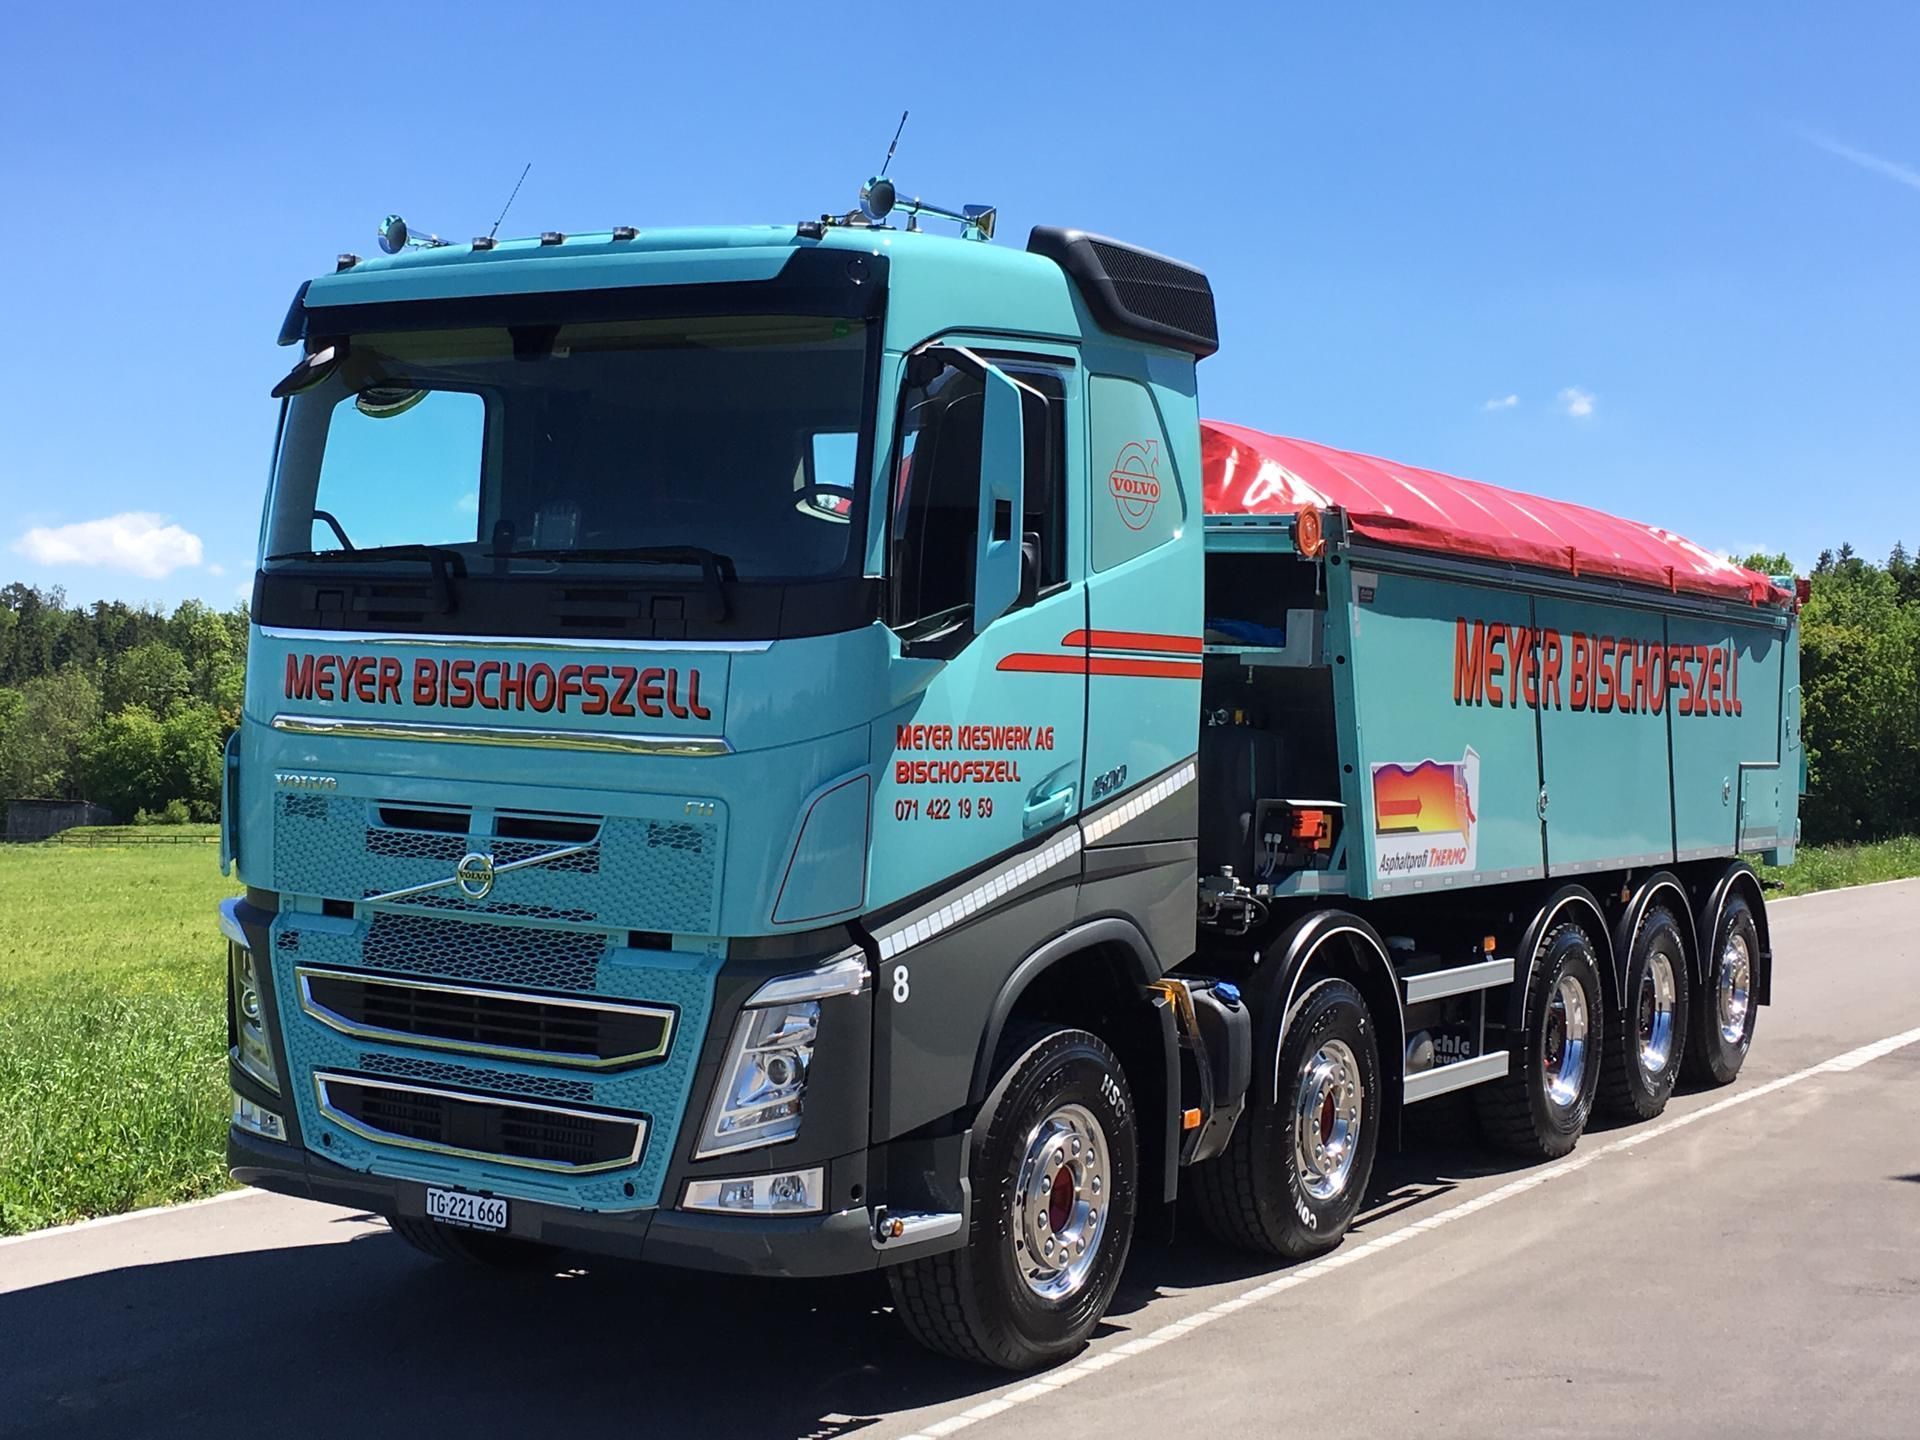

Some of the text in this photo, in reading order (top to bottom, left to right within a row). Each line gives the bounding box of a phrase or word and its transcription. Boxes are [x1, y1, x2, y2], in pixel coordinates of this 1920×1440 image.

[1112, 477, 1159, 497] VOLVO
[1453, 616, 1743, 718] MEYER BISCHOFSZELL
[285, 653, 711, 721] MEYER BISCHOFSZELL
[897, 724, 1054, 751] MEYER KIESWERK AG
[274, 773, 337, 791] VOLVO
[895, 761, 1021, 784] BISCHOFSZELL
[895, 797, 993, 821] 071 422 19 59
[1379, 847, 1467, 875] Asphaltprofi THERMO
[459, 871, 491, 881] VOLVO
[893, 965, 910, 1003] 8
